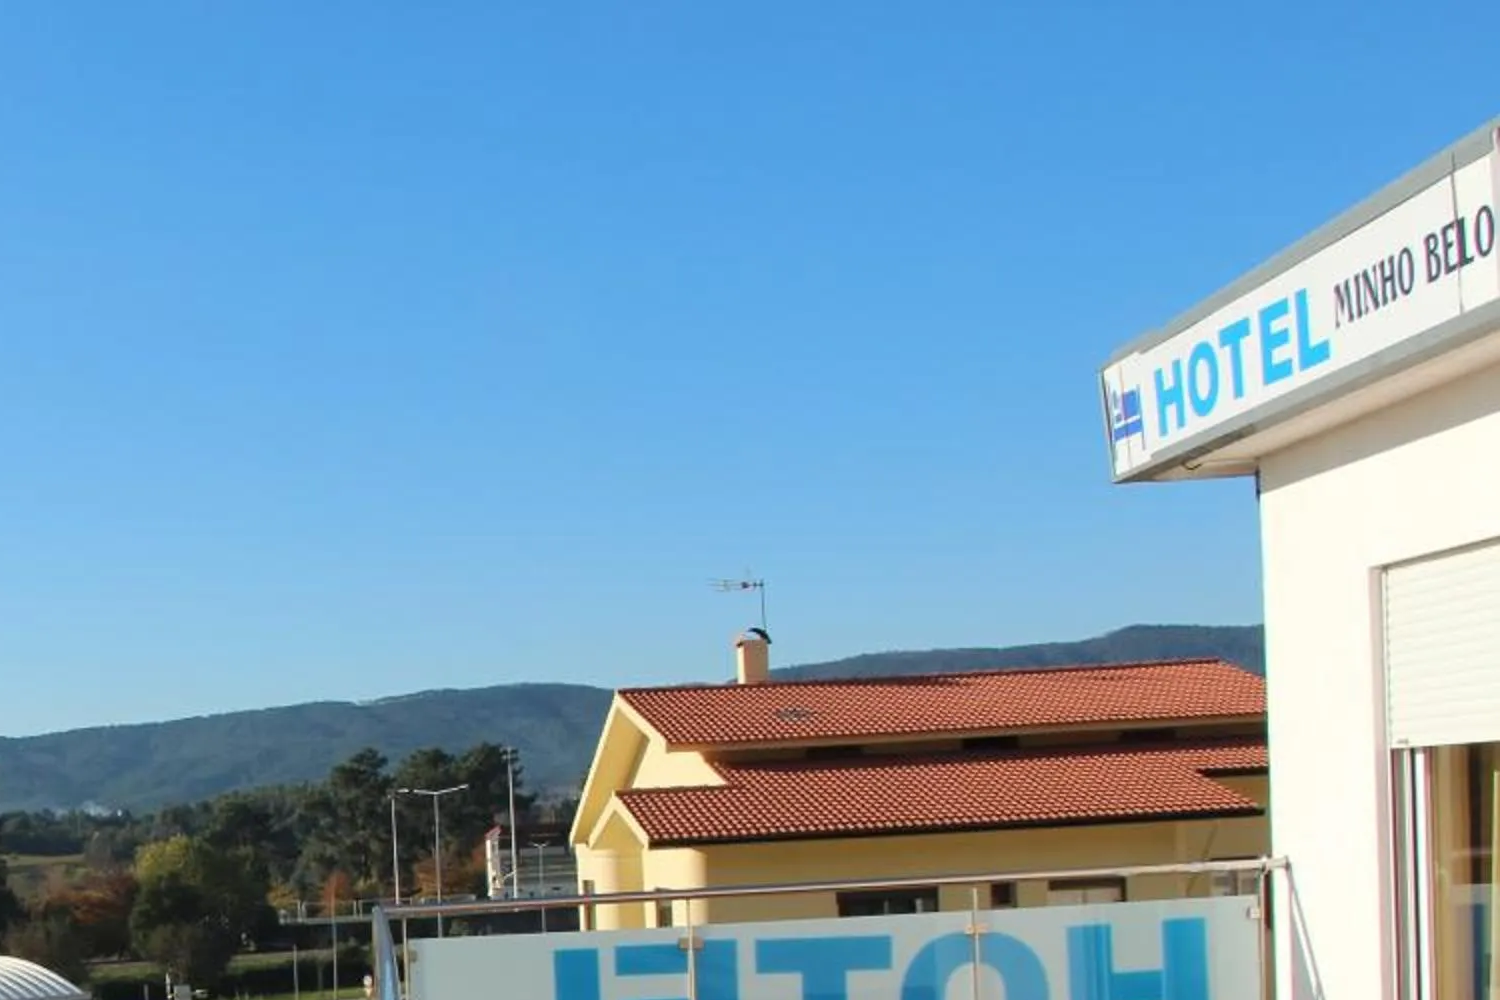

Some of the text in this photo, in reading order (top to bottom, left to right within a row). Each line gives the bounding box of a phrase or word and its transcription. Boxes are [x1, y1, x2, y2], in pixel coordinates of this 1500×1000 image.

[1154, 205, 1495, 437] HOTEL MINHO BELO
